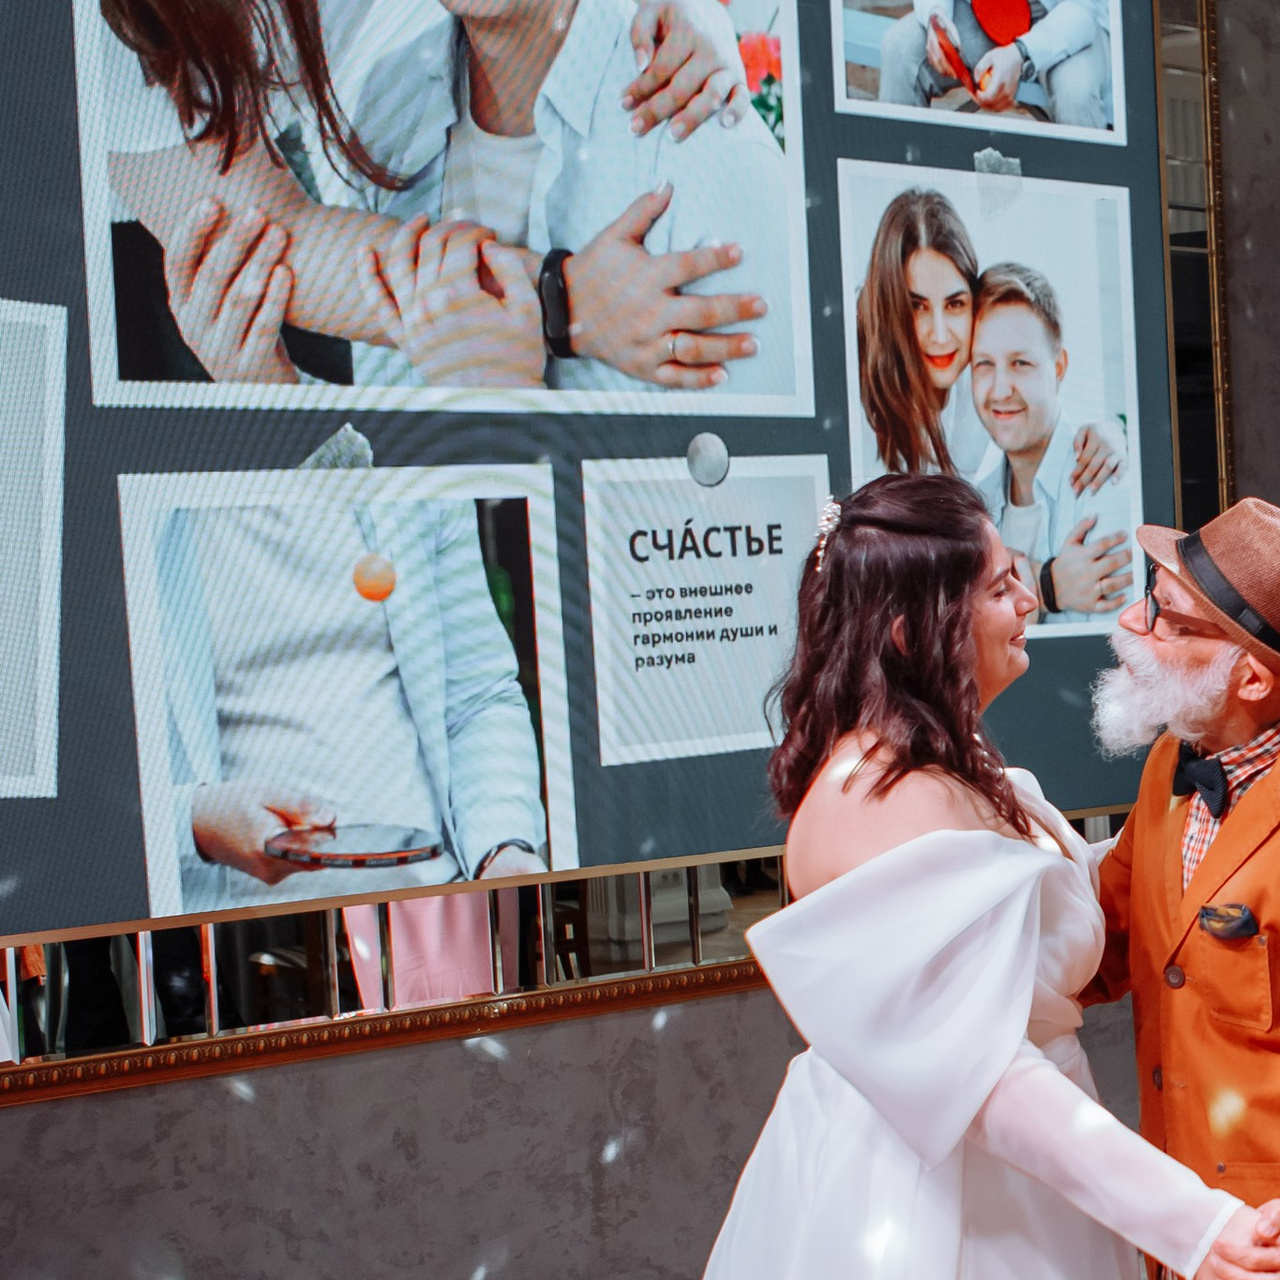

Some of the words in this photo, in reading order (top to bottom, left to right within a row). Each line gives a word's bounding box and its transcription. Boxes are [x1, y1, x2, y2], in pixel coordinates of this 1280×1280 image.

[646, 587, 676, 600] это
[680, 581, 753, 599] внешнее
[632, 605, 734, 627] проявление
[634, 628, 716, 648] гармонии
[720, 625, 764, 643] души
[768, 624, 778, 636] и
[635, 653, 696, 673] разума
